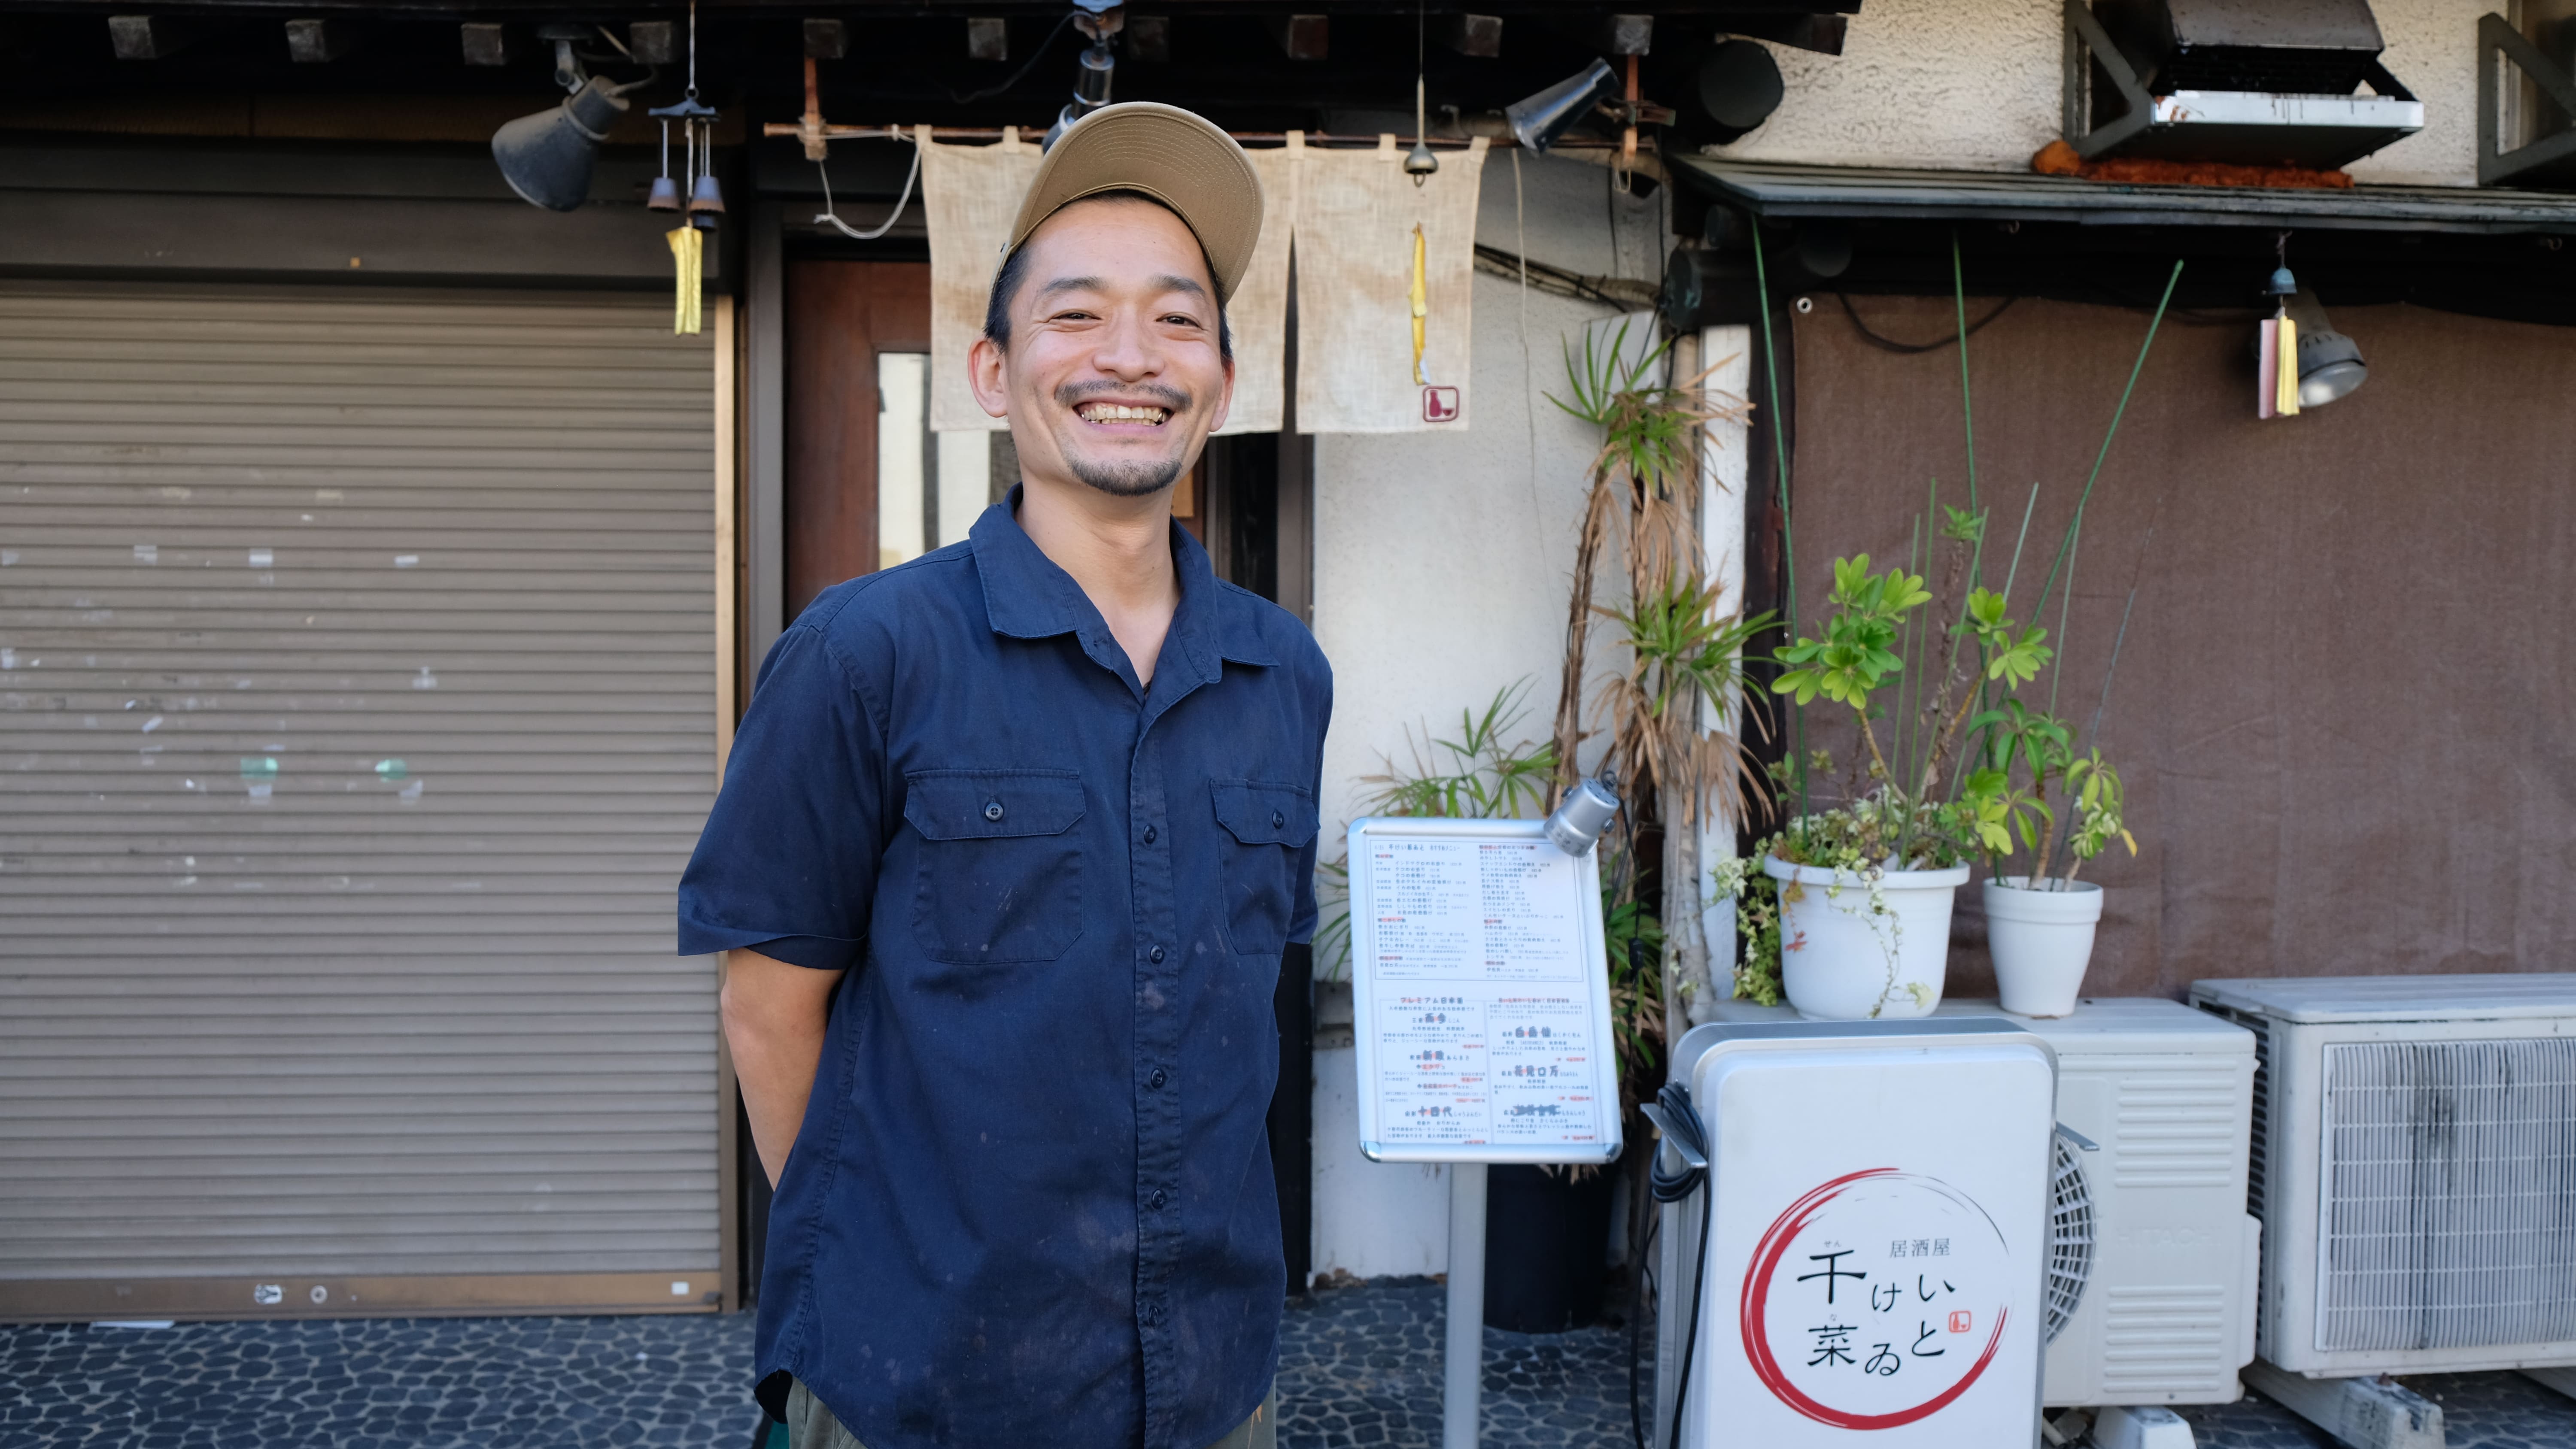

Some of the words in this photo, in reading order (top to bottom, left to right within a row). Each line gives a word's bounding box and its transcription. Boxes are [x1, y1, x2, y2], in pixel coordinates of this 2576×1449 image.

[2116, 1227, 2222, 1247] HITACHI
[1889, 1238, 1950, 1258] 居酒屋
